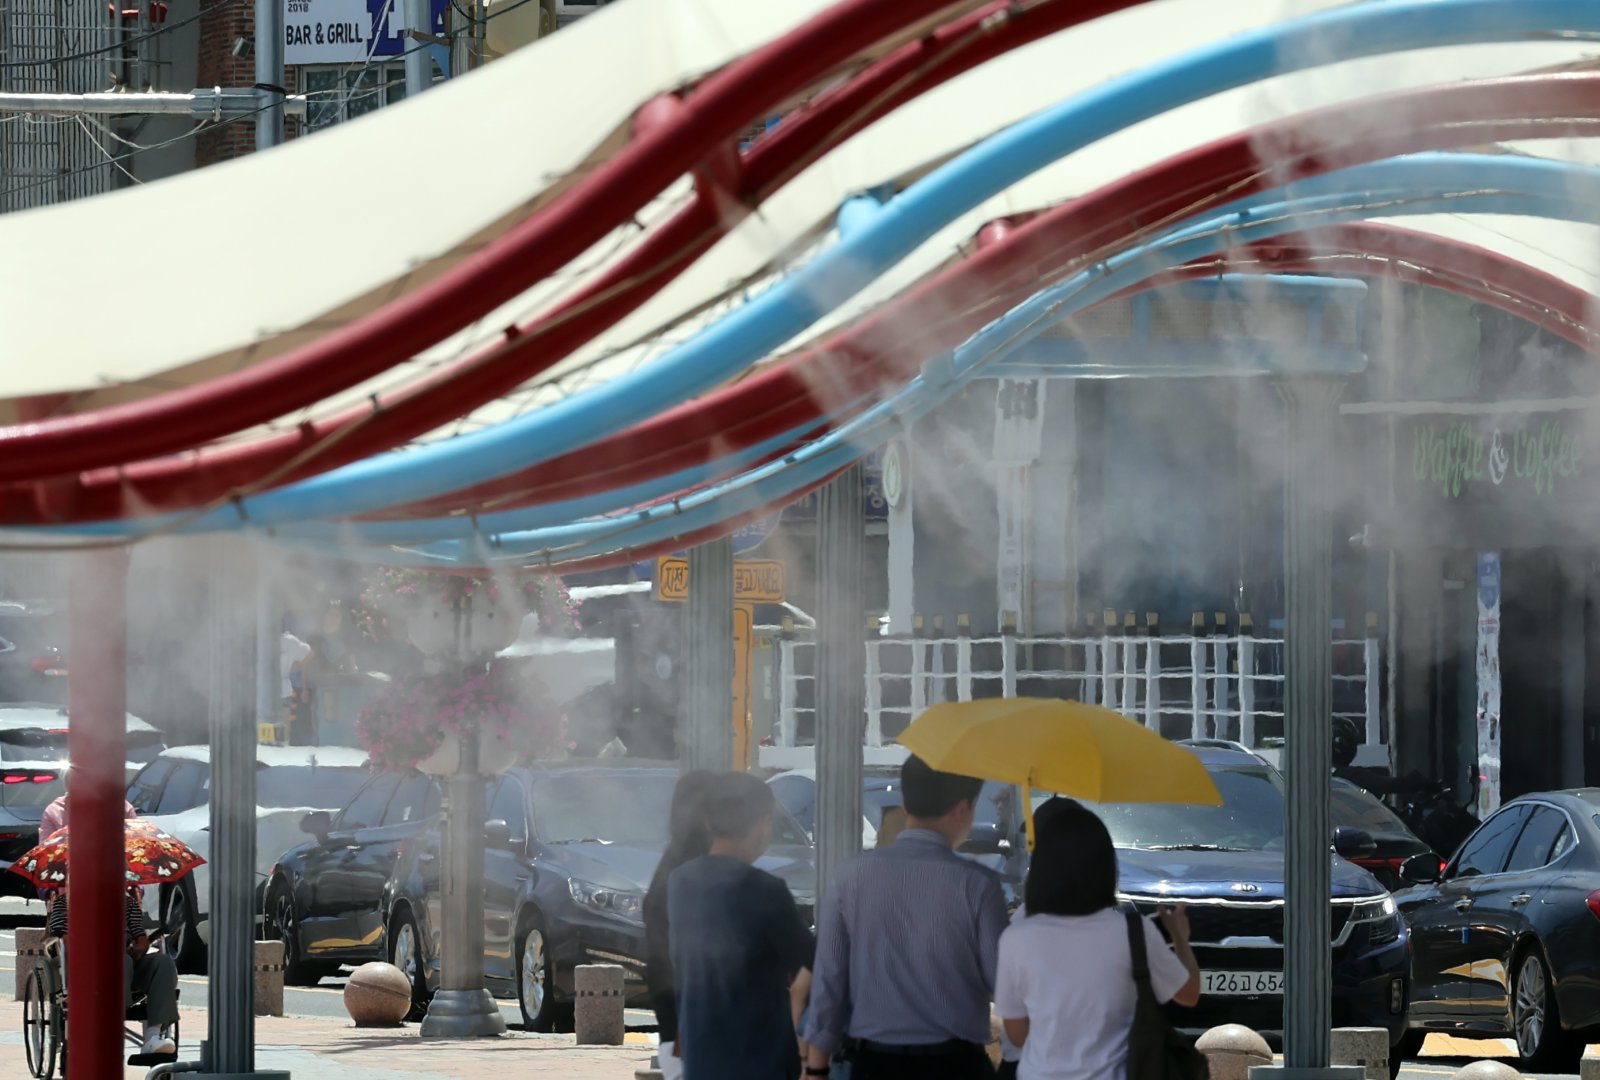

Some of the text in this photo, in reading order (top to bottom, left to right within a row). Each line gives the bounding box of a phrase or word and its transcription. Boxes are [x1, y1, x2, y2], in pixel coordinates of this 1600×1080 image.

[286, 22, 363, 45] BAR & GRILL
[1413, 420, 1583, 498] Waffle & Coffee
[664, 566, 688, 593] 자전
